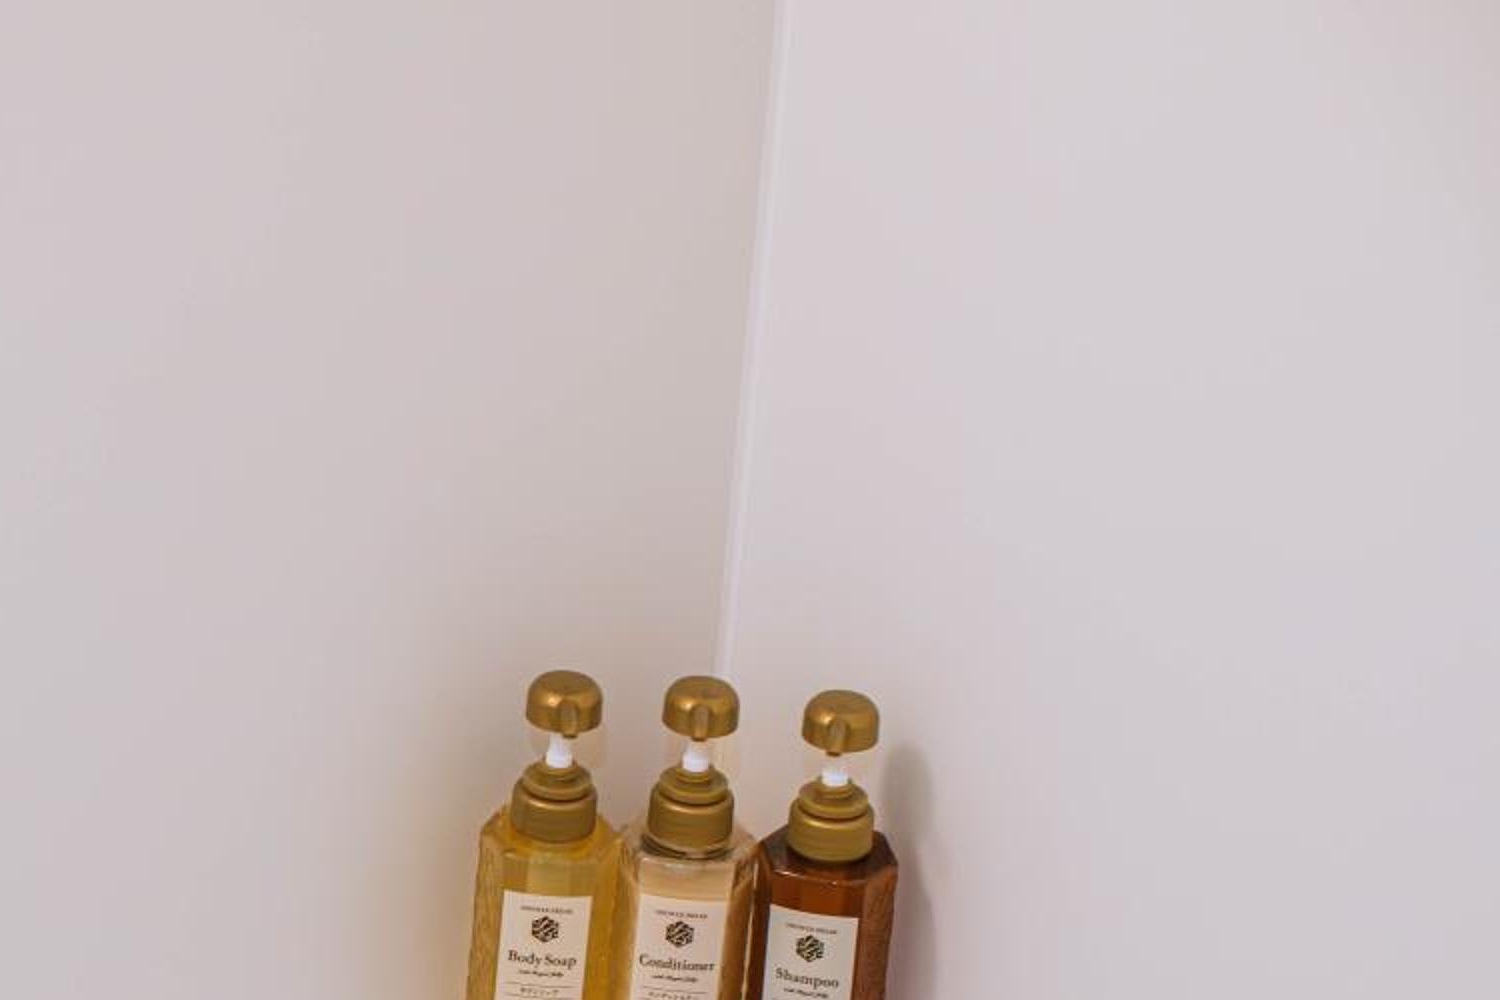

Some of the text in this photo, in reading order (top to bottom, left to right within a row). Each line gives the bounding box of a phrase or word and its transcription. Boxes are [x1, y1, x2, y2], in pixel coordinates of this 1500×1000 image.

[507, 949, 577, 970] Body Soap
[639, 953, 716, 972] Conditioner
[775, 967, 840, 990] Shampoo
